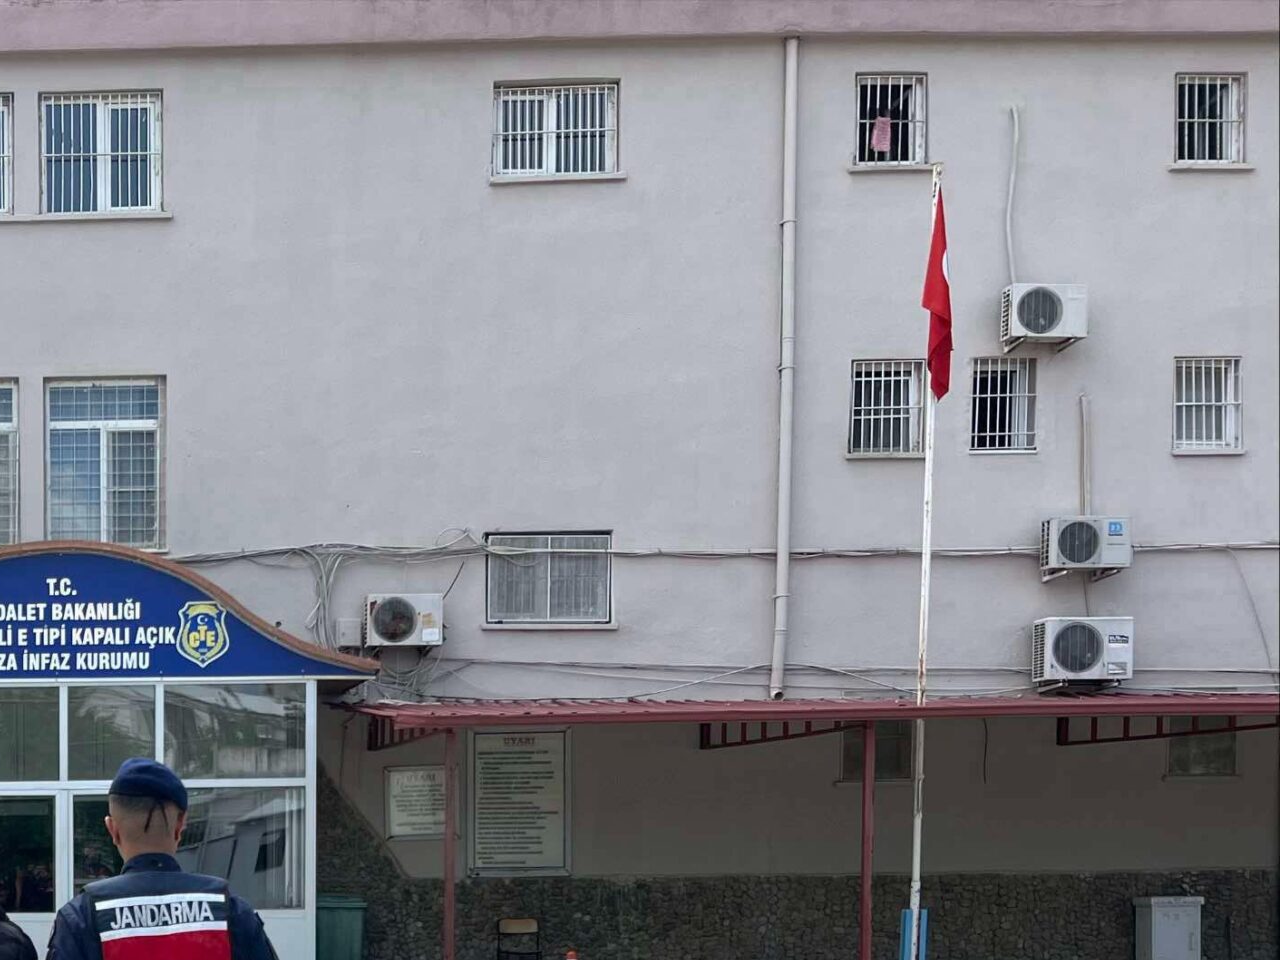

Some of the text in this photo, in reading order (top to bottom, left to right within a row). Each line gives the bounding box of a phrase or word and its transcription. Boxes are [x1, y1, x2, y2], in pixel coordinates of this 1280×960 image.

[46, 578, 77, 596] T.C.
[52, 598, 141, 621] BAKANLIĞI
[17, 628, 28, 646] E
[33, 623, 66, 646] TİPİ
[71, 627, 130, 645] KAPALI
[135, 626, 176, 649] AÇIK
[23, 649, 71, 671] İNFAZ
[76, 651, 150, 670] KURUMU
[110, 900, 214, 930] JANDARMA
